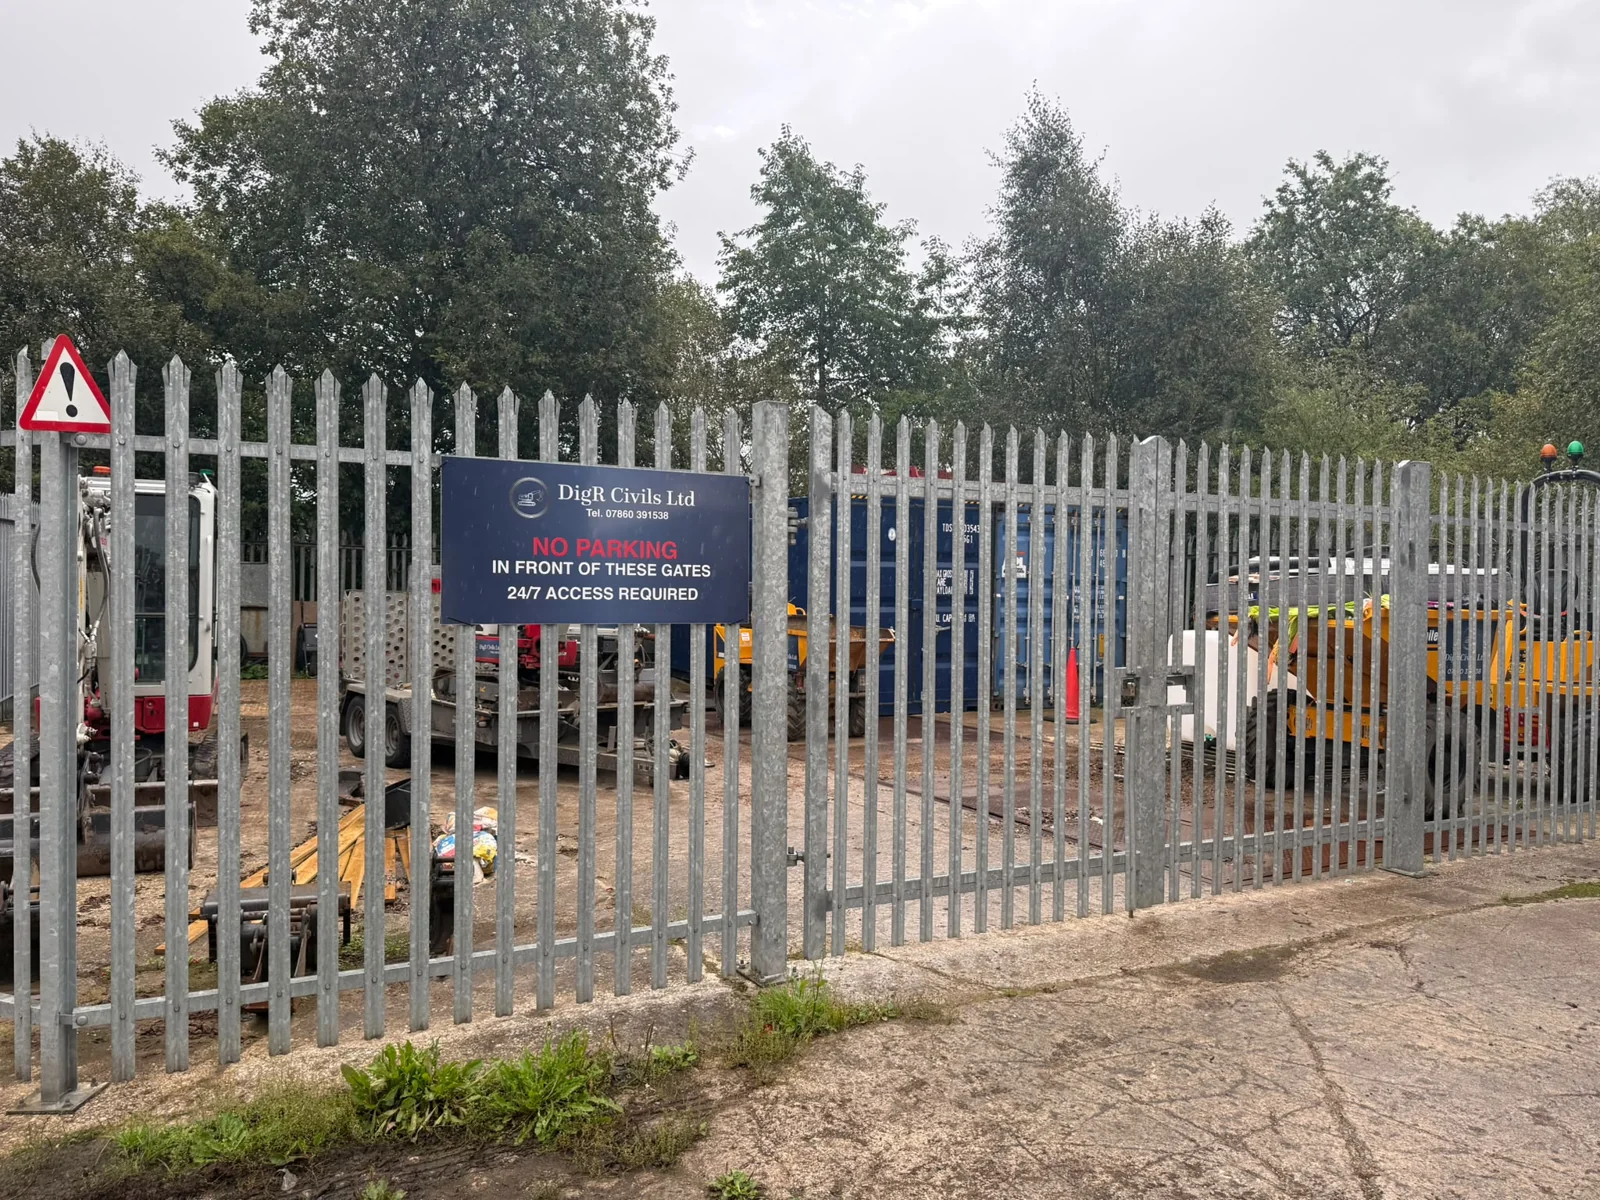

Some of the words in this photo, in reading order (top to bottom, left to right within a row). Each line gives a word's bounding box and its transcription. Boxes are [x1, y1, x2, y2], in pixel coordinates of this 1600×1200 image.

[558, 483, 605, 506] DigR
[611, 486, 661, 505] Civils
[666, 490, 695, 507] Ltd
[586, 508, 603, 518] Tel.
[606, 509, 634, 519] 07860
[636, 510, 669, 520] 391538
[942, 523, 953, 532] TDS
[532, 537, 569, 557] NO
[576, 538, 678, 559] PARKING
[492, 560, 510, 574] IN
[515, 560, 574, 575] FRONT
[578, 561, 601, 576] OF
[605, 562, 658, 577] THESE
[661, 563, 712, 578] GATES
[507, 585, 541, 601] 24/7
[545, 586, 614, 601] ACCESS
[618, 586, 699, 601] REQUIRED
